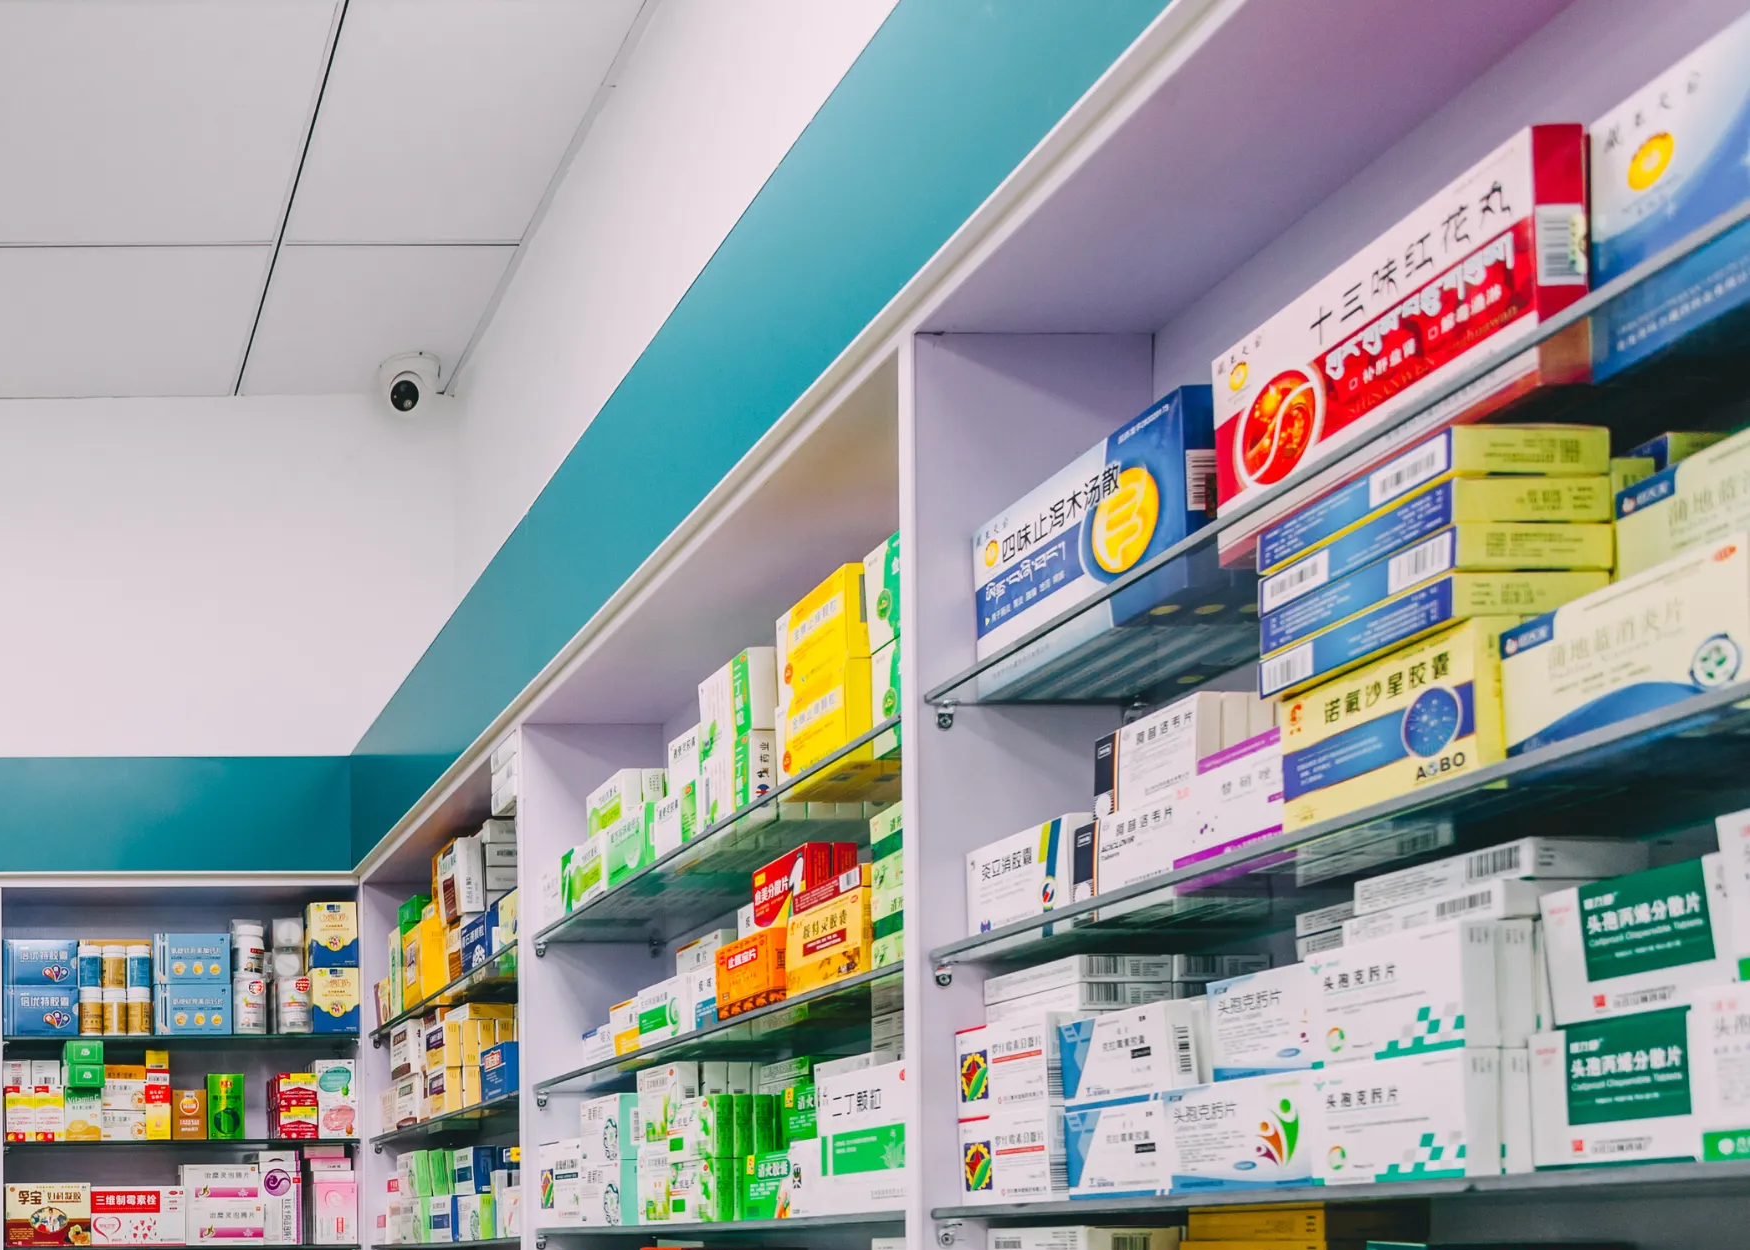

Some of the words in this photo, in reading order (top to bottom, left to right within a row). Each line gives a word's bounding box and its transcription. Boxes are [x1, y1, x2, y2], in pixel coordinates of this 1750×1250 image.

[1309, 180, 1512, 345] 十三味红花丸
[1002, 462, 1121, 563] 四味止泻木汤散
[733, 664, 746, 727] 二丁颗粒
[1323, 650, 1451, 725] 诺氟沙星胶囊
[1136, 711, 1193, 746] 阿昔洛韦片
[1116, 806, 1173, 836] 阿昔洛韦片
[981, 847, 1033, 882] 炎立消胶囊
[1586, 891, 1701, 934] 头孢丙烯分散片
[1323, 963, 1397, 992] 头孢克肟片
[20, 996, 69, 1008] 倍优特胶囊
[1217, 989, 1282, 1016] 头孢克肟片
[1570, 1046, 1683, 1079] 头孢丙烯分散片
[68, 1095, 92, 1104] Vitamin
[832, 1087, 882, 1117] 二丁颗粒
[1173, 1101, 1237, 1123] 头孢克肟片
[1325, 1086, 1399, 1110] 头孢克肟片
[95, 1194, 157, 1206] 三维制霉素栓
